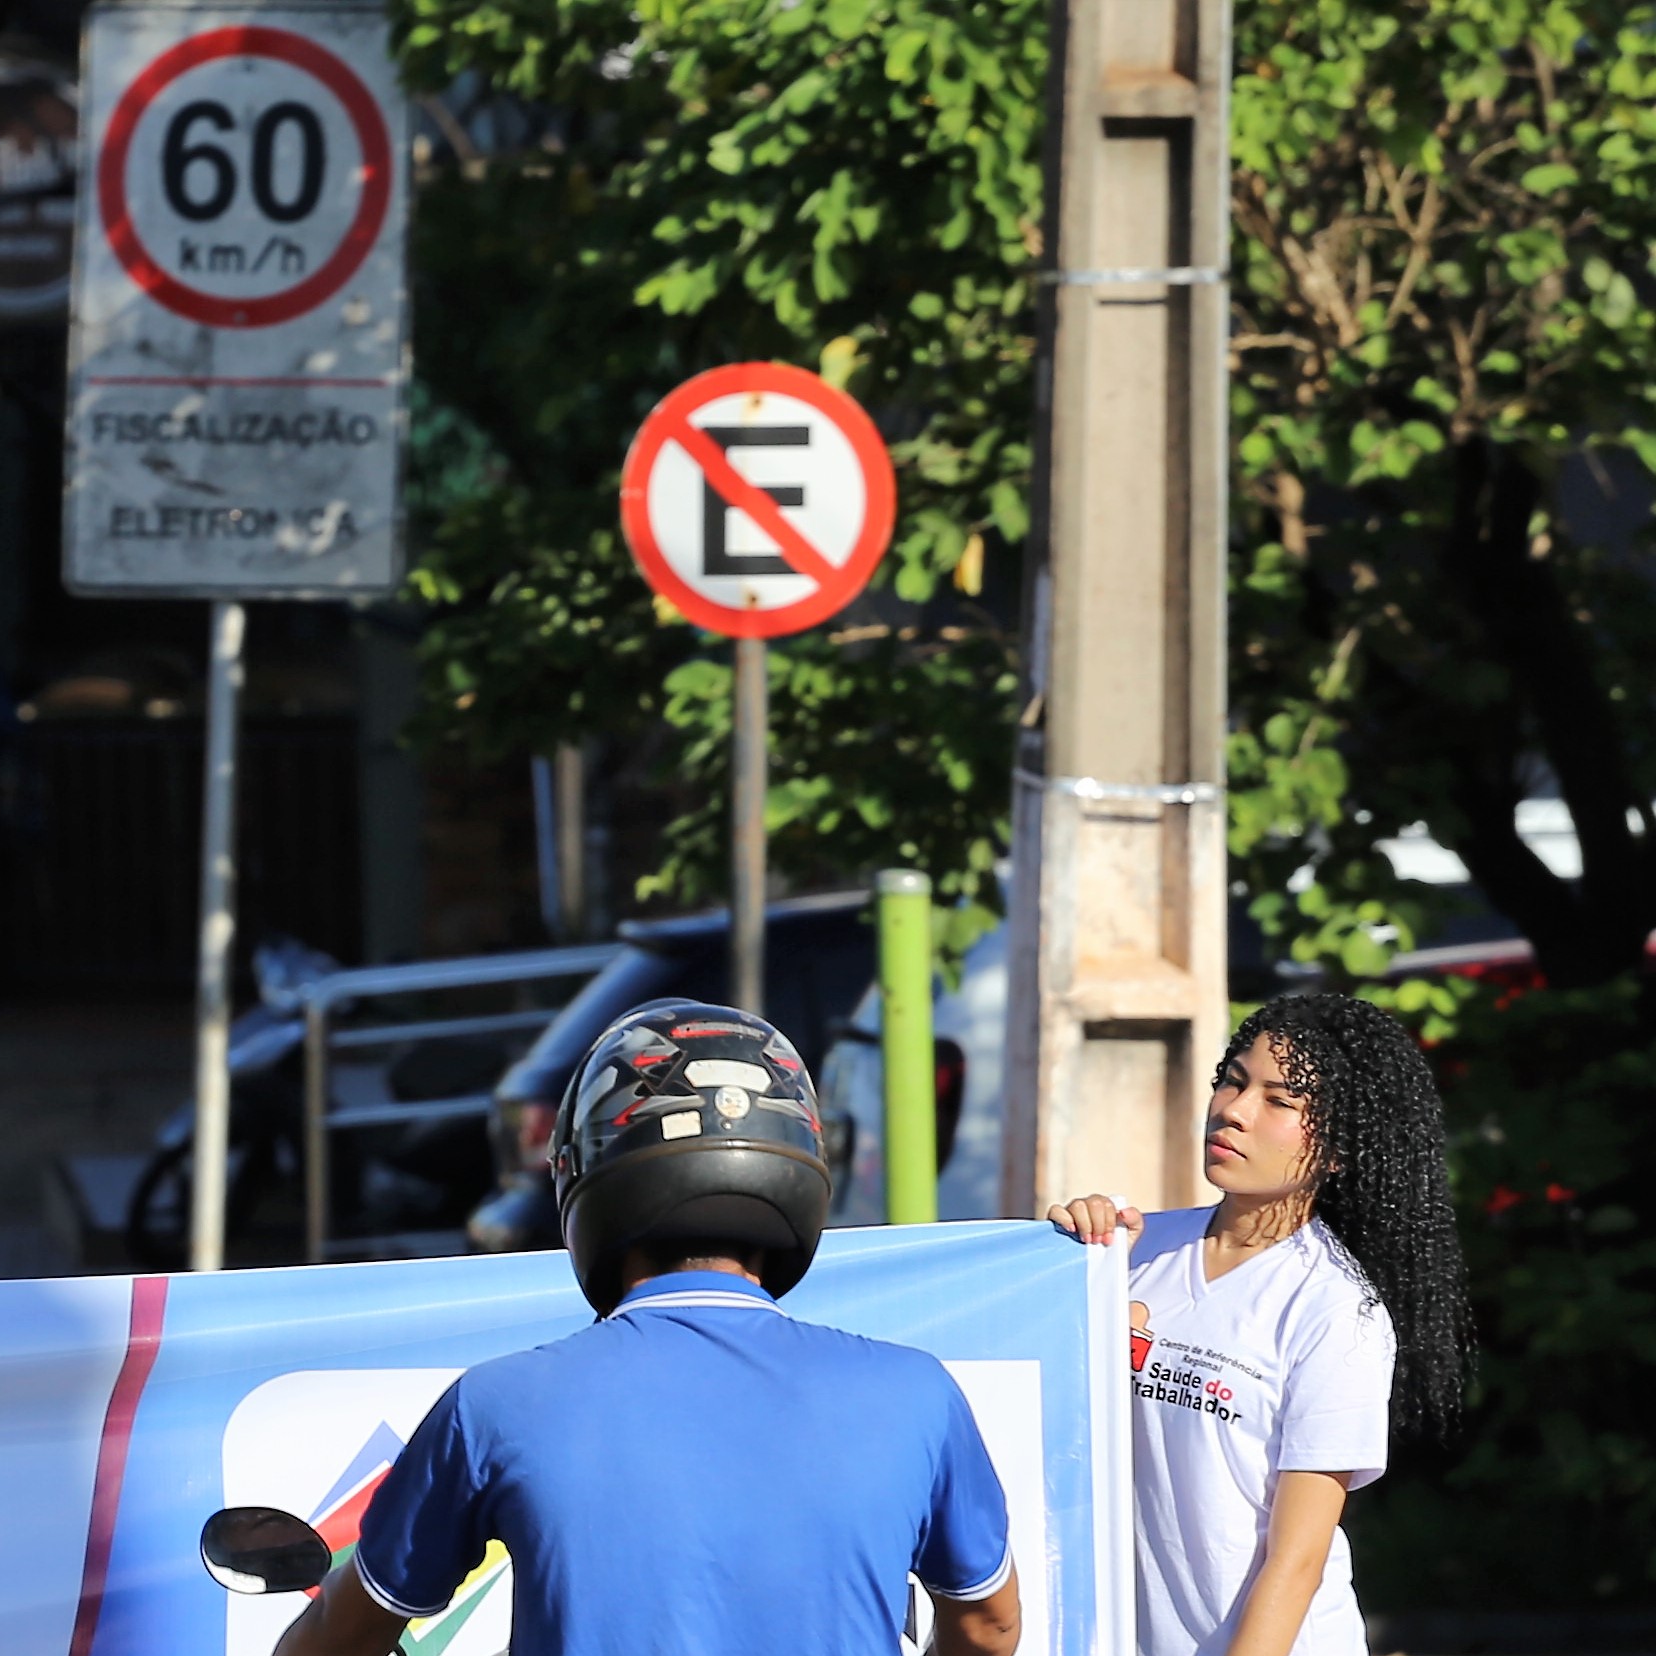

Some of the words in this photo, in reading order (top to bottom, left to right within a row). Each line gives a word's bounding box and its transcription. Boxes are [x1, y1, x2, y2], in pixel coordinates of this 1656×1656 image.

[162, 99, 326, 224] 60
[179, 233, 306, 275] km/h
[92, 408, 378, 447] FISCALIZAÇÃO
[1149, 1362, 1202, 1389] Saúde
[1205, 1379, 1233, 1401] do
